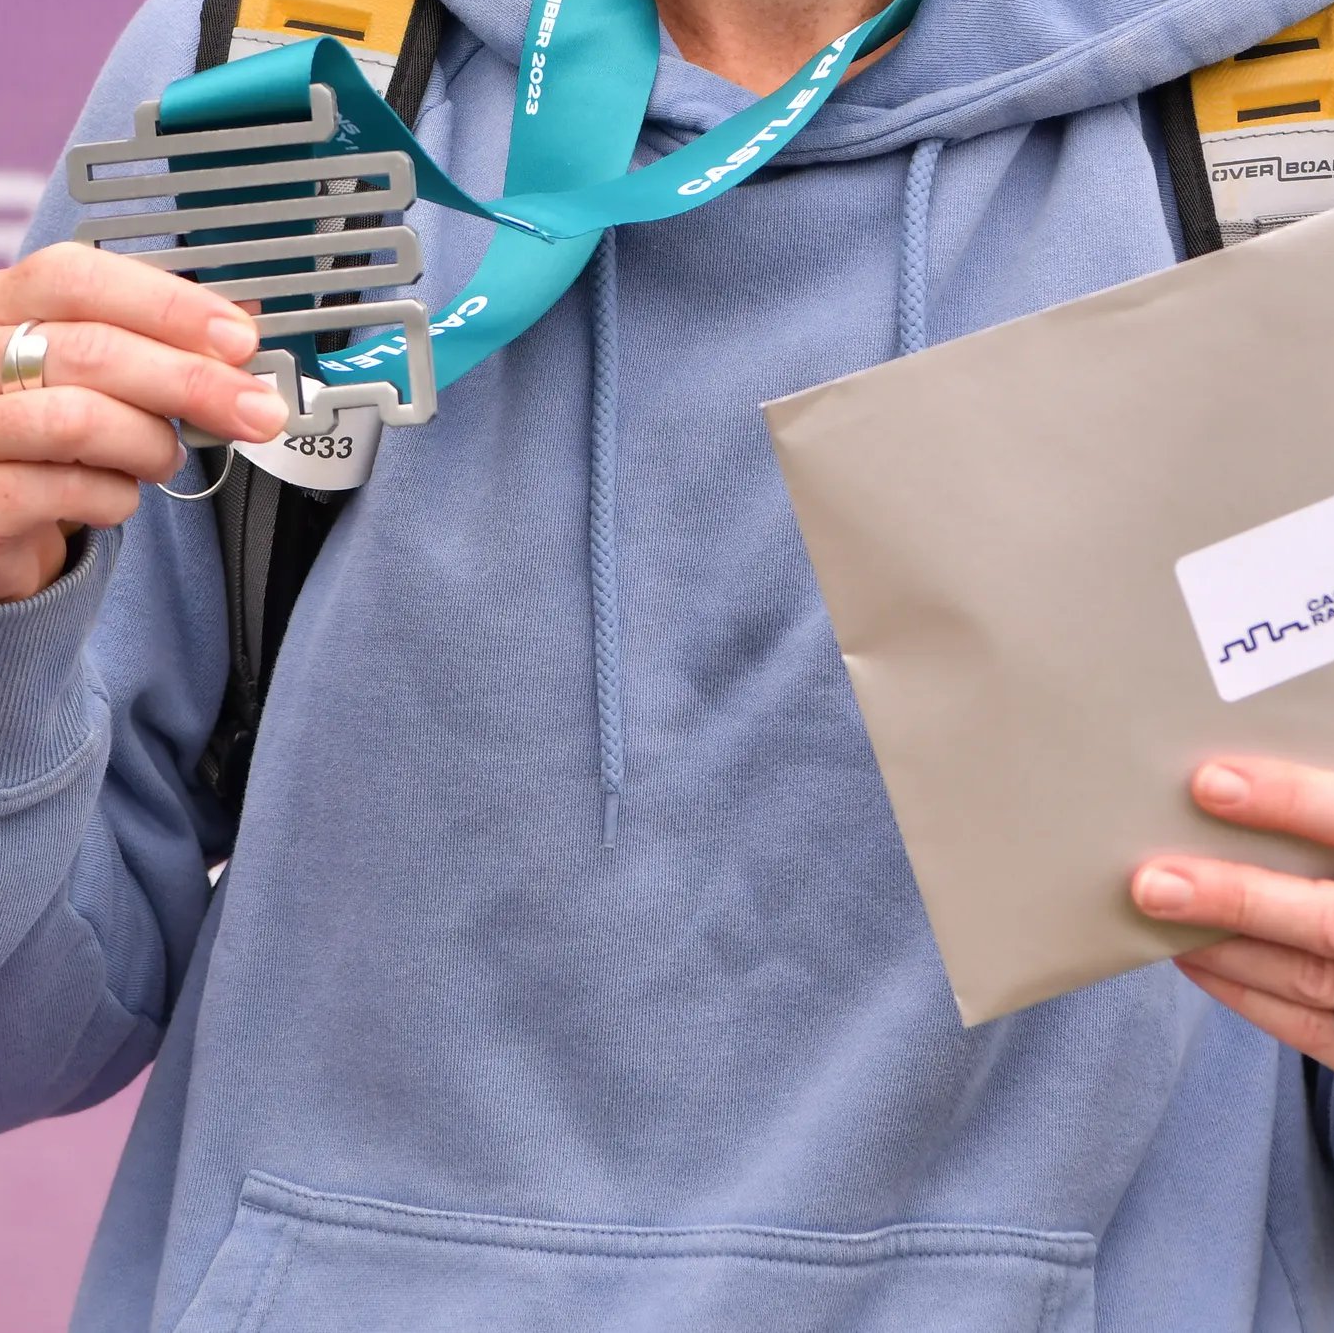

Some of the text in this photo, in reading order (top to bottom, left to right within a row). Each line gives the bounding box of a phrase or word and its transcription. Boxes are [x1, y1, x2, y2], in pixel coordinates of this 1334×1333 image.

[526, 52, 546, 116] 2023
[677, 87, 819, 195] CASTLE
[1212, 164, 1274, 182] OVER
